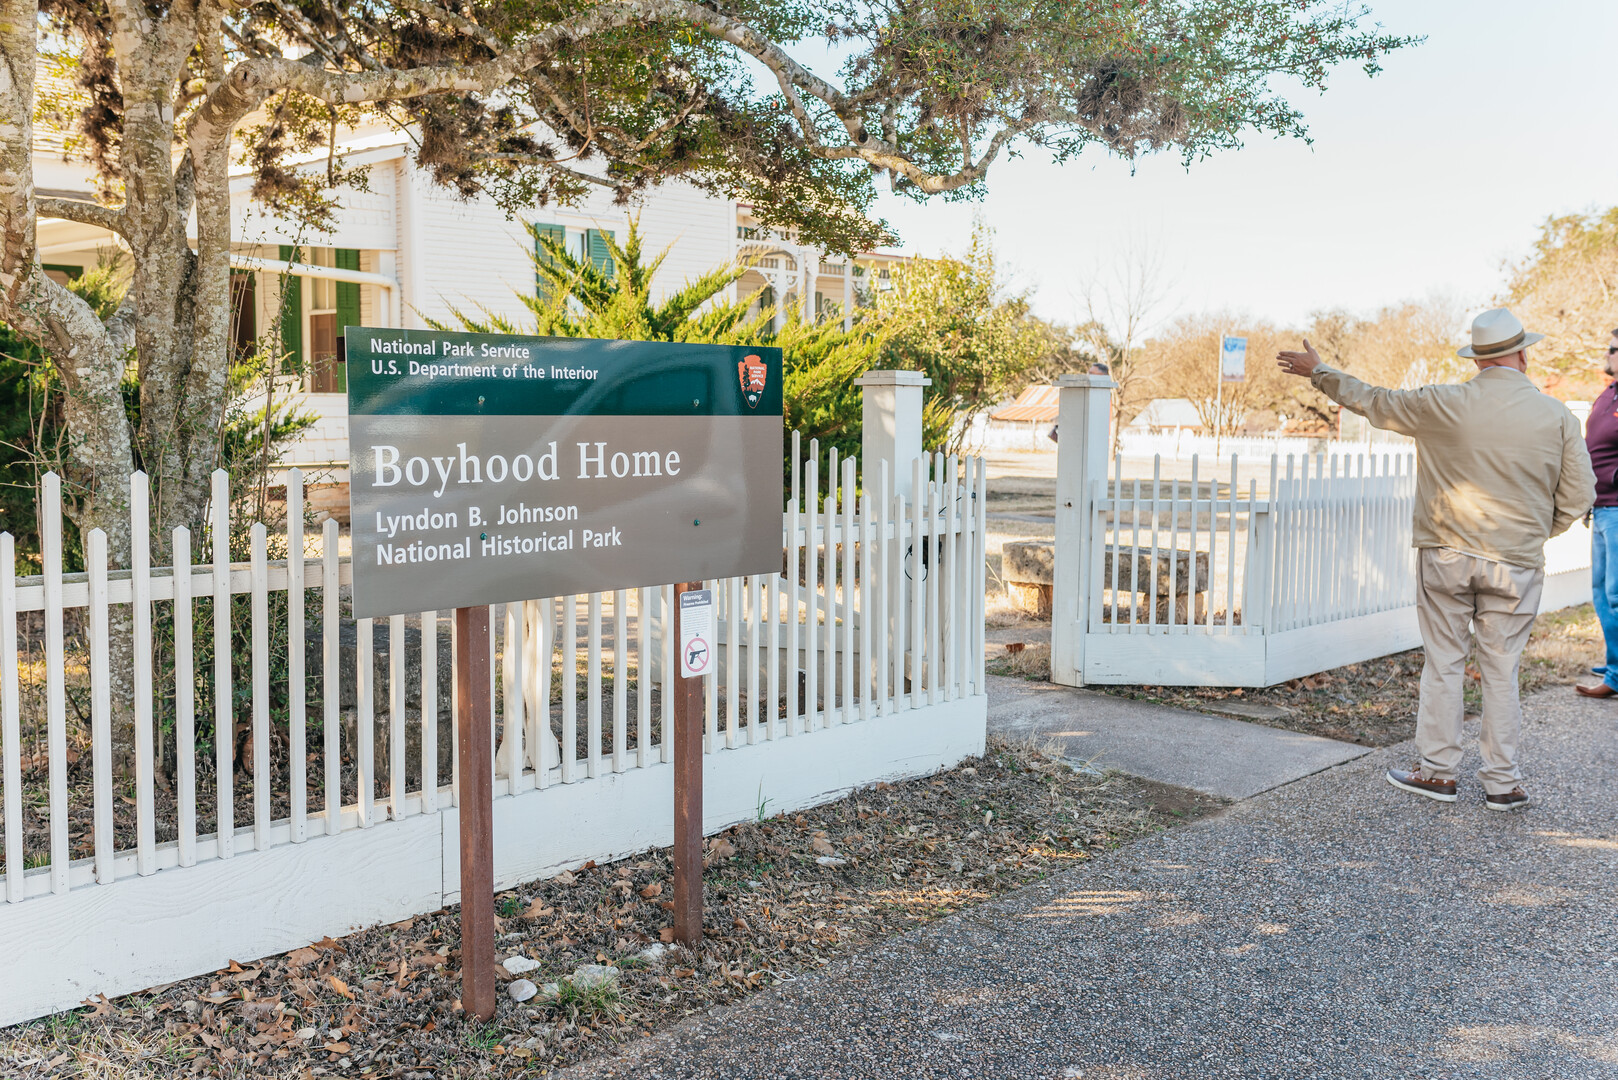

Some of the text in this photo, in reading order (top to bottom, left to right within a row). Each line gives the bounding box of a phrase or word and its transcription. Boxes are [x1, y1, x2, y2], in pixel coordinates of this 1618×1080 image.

[371, 338, 530, 359] National Park Service
[371, 360, 599, 380] U.S. Department of the Interior
[371, 441, 681, 498] Boyhood Home
[376, 503, 578, 538] Lyndon B. Johnson
[376, 527, 622, 566] National Historical Park
